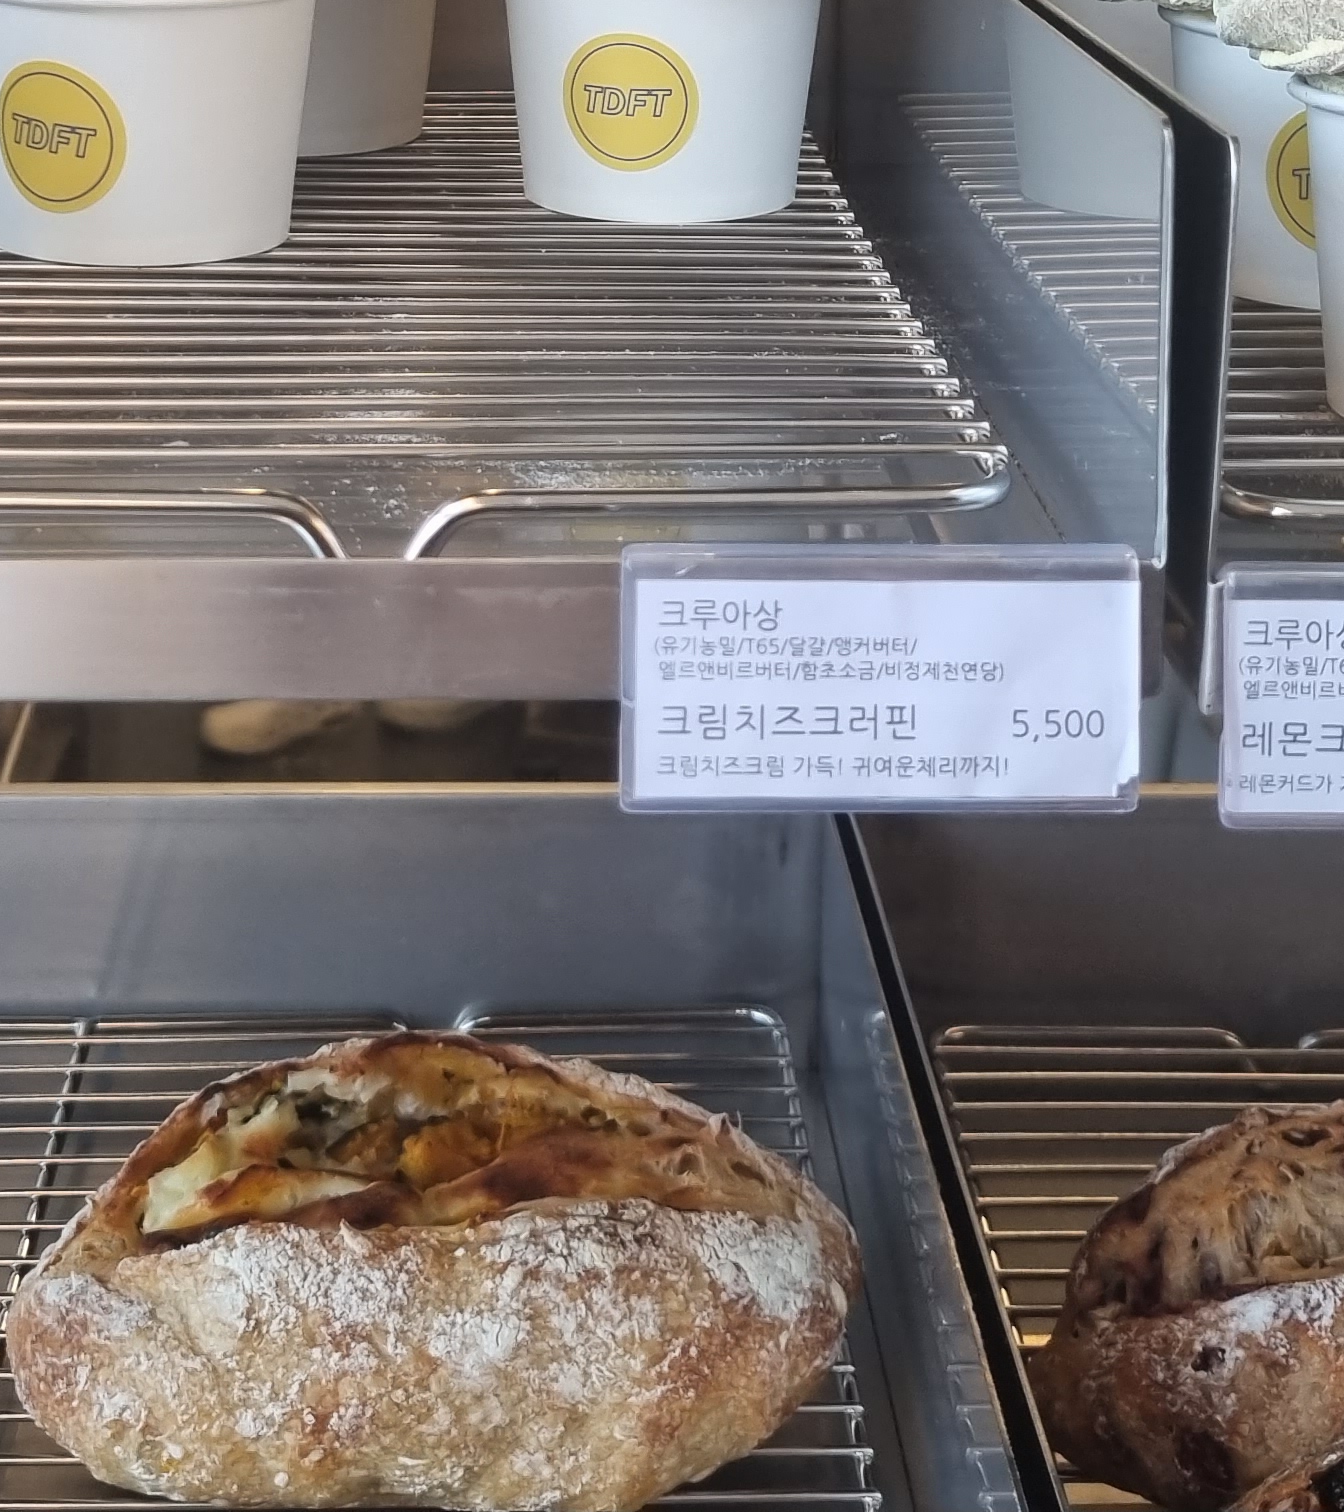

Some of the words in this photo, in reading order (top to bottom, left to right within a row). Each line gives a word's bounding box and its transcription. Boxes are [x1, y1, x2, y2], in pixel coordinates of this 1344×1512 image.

[582, 83, 673, 119] TDFT
[11, 110, 97, 160] TDFT
[658, 598, 784, 632] 크루아상
[656, 702, 917, 741] 크림치즈크러핀
[1011, 709, 1106, 744] 5,500
[656, 753, 785, 780] 크림치즈크림
[793, 755, 843, 780] 가득!
[851, 754, 1009, 780] 귀여운체리까지!
[1239, 774, 1333, 795] 레몬커드가
